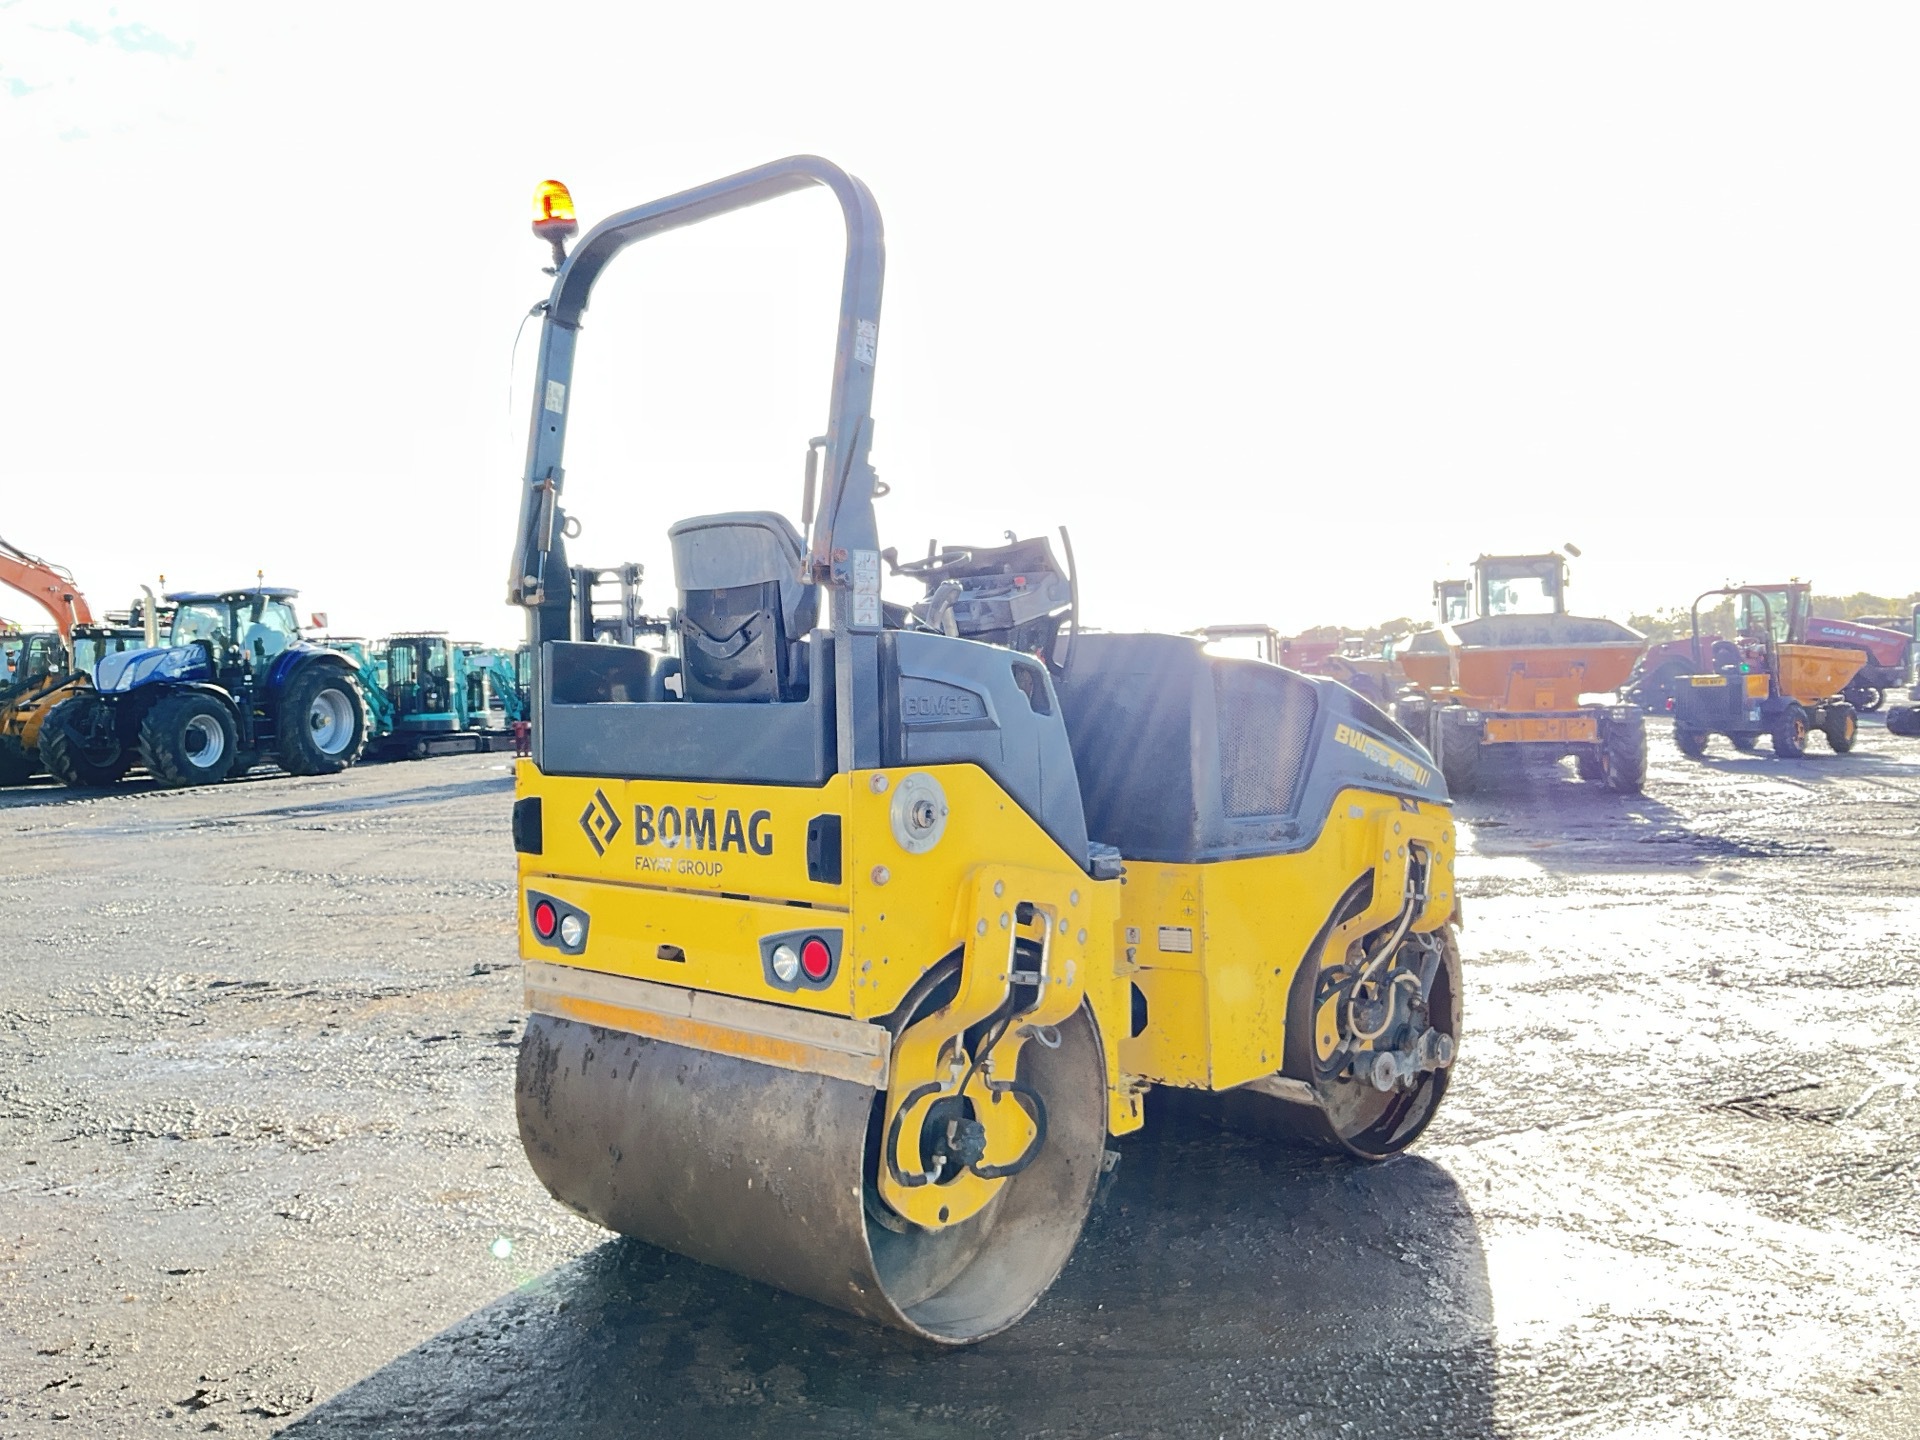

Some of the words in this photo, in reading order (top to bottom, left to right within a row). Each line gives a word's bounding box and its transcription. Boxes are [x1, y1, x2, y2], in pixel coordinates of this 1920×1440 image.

[1822, 627, 1845, 636] CASE
[634, 804, 773, 856] BOMAG
[635, 856, 673, 873] FAYAT
[677, 858, 723, 877] GROUP
